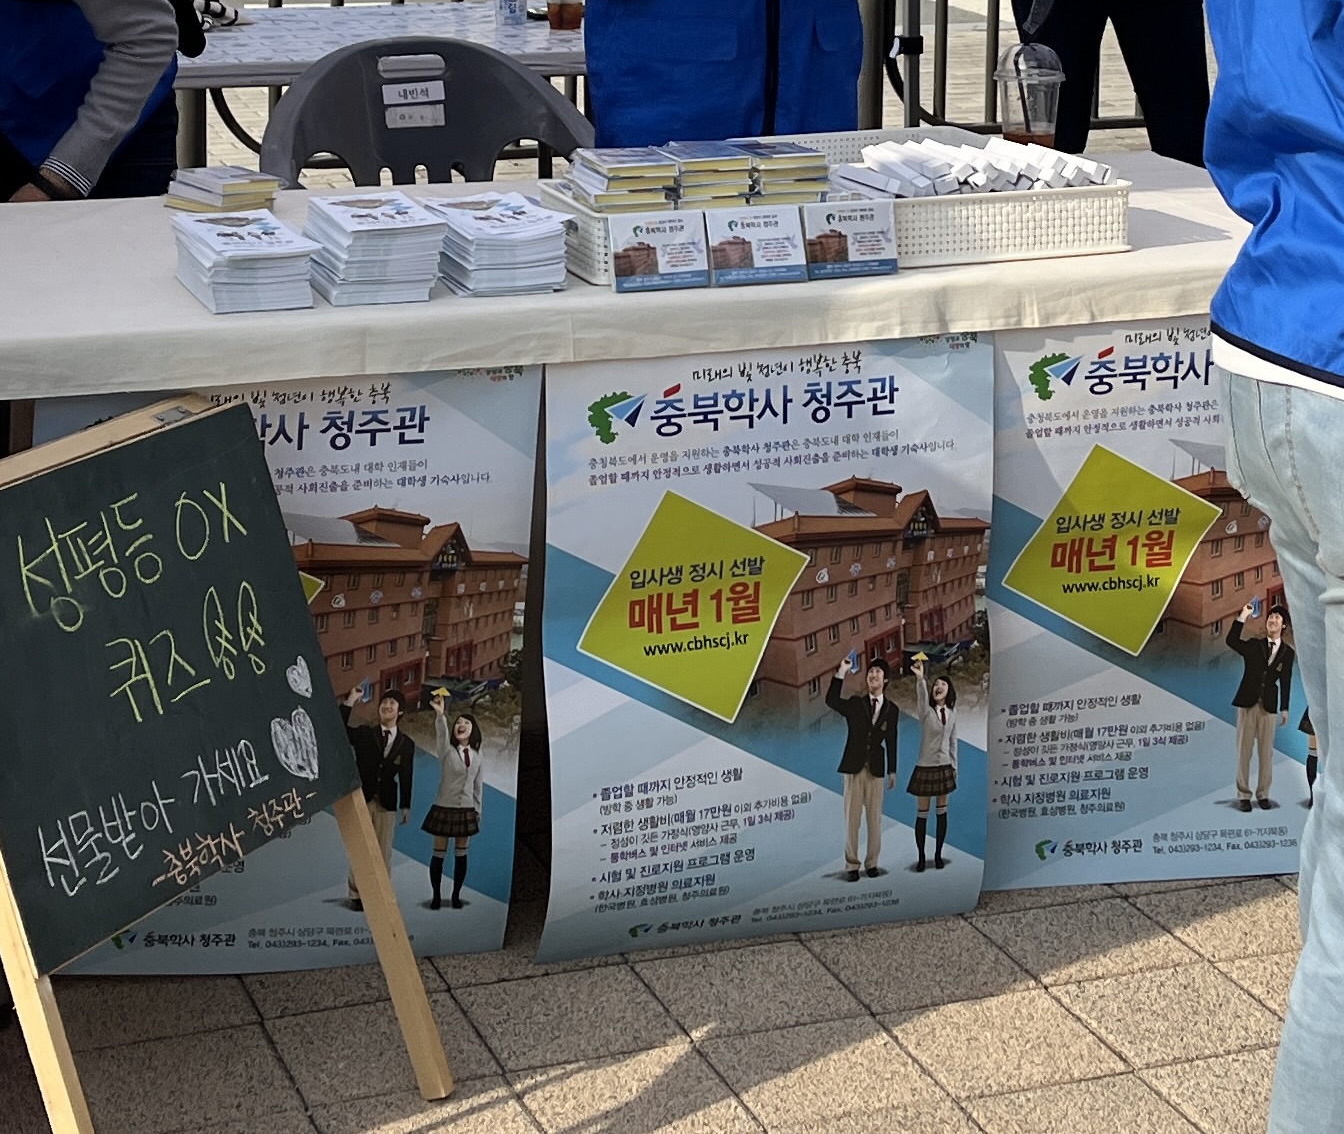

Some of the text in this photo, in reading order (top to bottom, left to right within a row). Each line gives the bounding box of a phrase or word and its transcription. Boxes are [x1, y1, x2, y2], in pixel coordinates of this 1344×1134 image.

[397, 86, 430, 101] 내빈석
[1084, 346, 1214, 395] 충북학사
[649, 374, 900, 437] 충북학사 청주관
[319, 405, 430, 450] 청주관
[1056, 507, 1181, 534] 입사생 정시 선발
[17, 492, 164, 633] 성평등
[1051, 530, 1176, 574] 매년 1월
[629, 555, 766, 590] 입사생 정시 선발
[1062, 575, 1160, 595] www.cbhscj.kr
[628, 580, 762, 635] 매년 1월
[642, 630, 749, 657] www.cbhscj.kr
[180, 739, 270, 807] 가세요
[720, 767, 743, 782] 생활
[1111, 839, 1143, 855] 청주관
[143, 930, 236, 947] 충북학사 청주관
